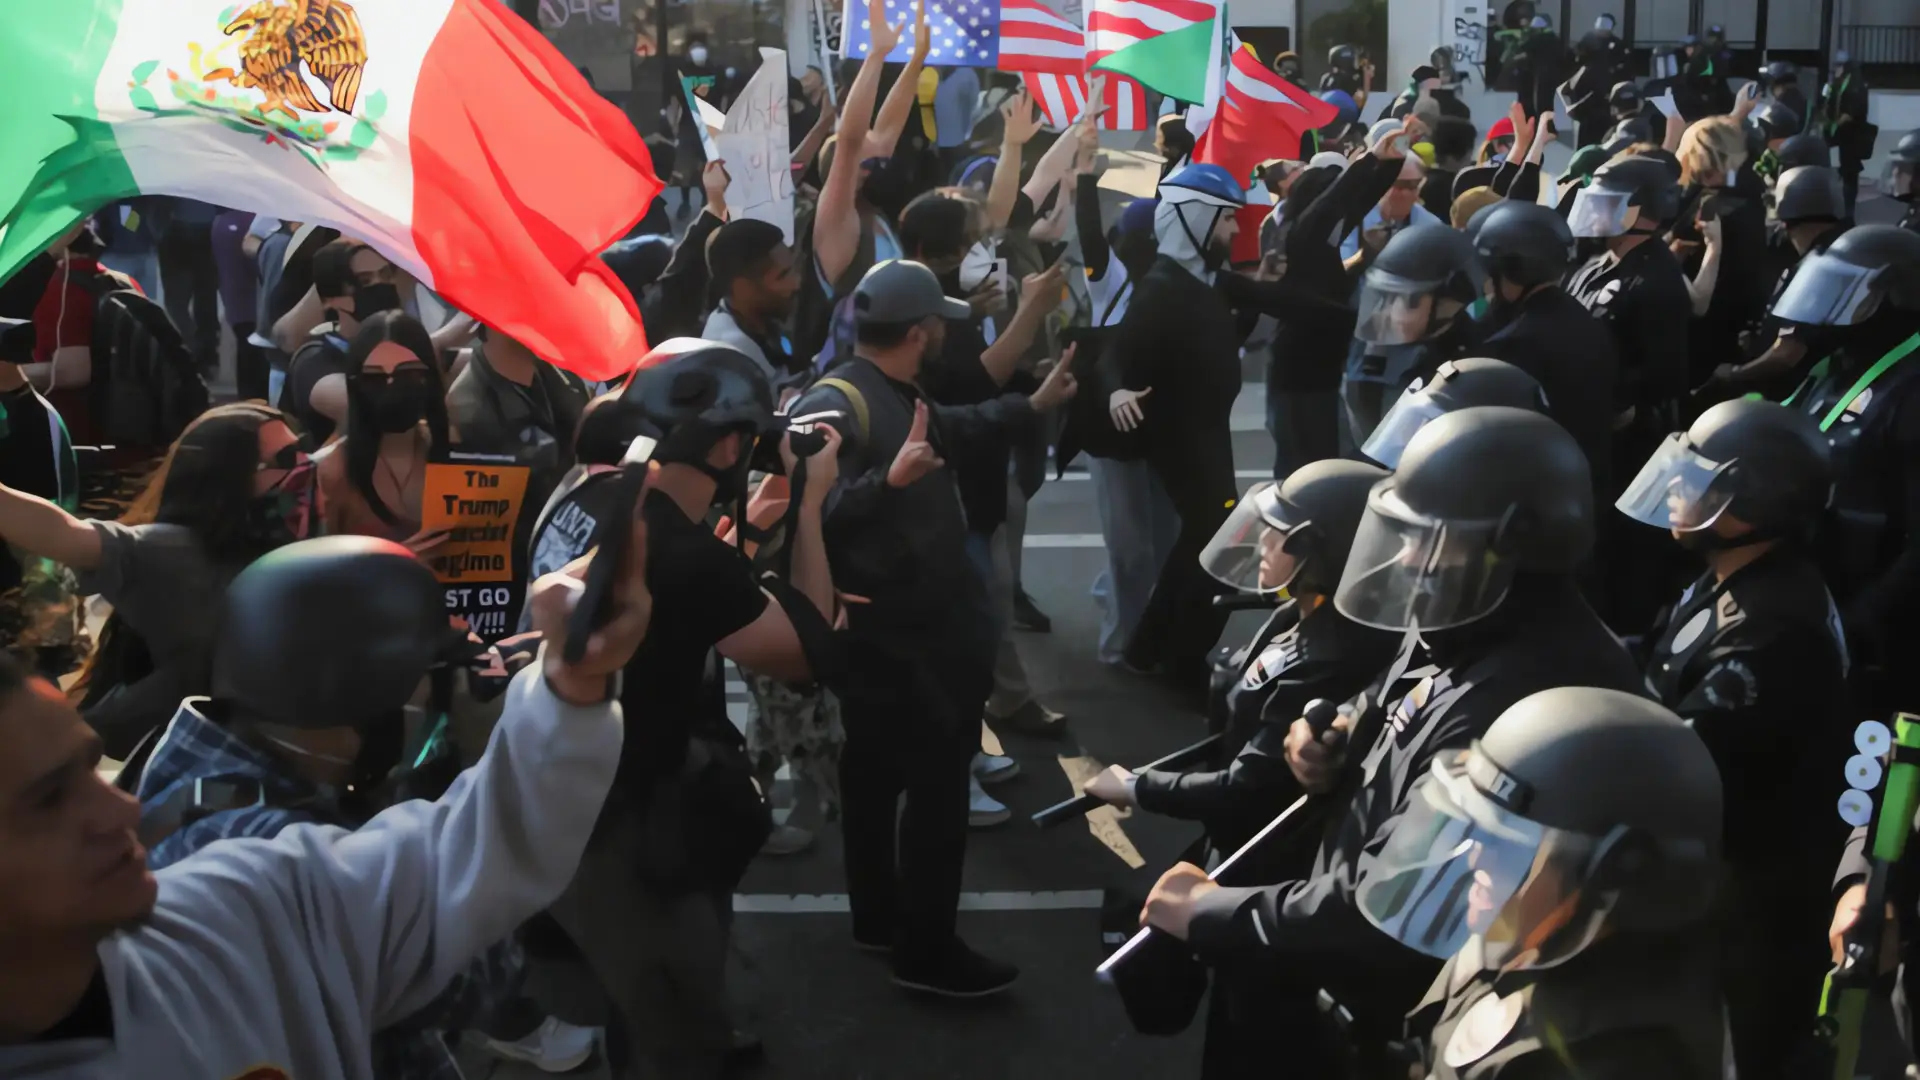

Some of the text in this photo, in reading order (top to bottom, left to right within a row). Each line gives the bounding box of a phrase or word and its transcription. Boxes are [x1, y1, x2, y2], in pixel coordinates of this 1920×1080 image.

[464, 470, 499, 488] The
[443, 494, 510, 518] Trump
[445, 587, 511, 608] ST GO
